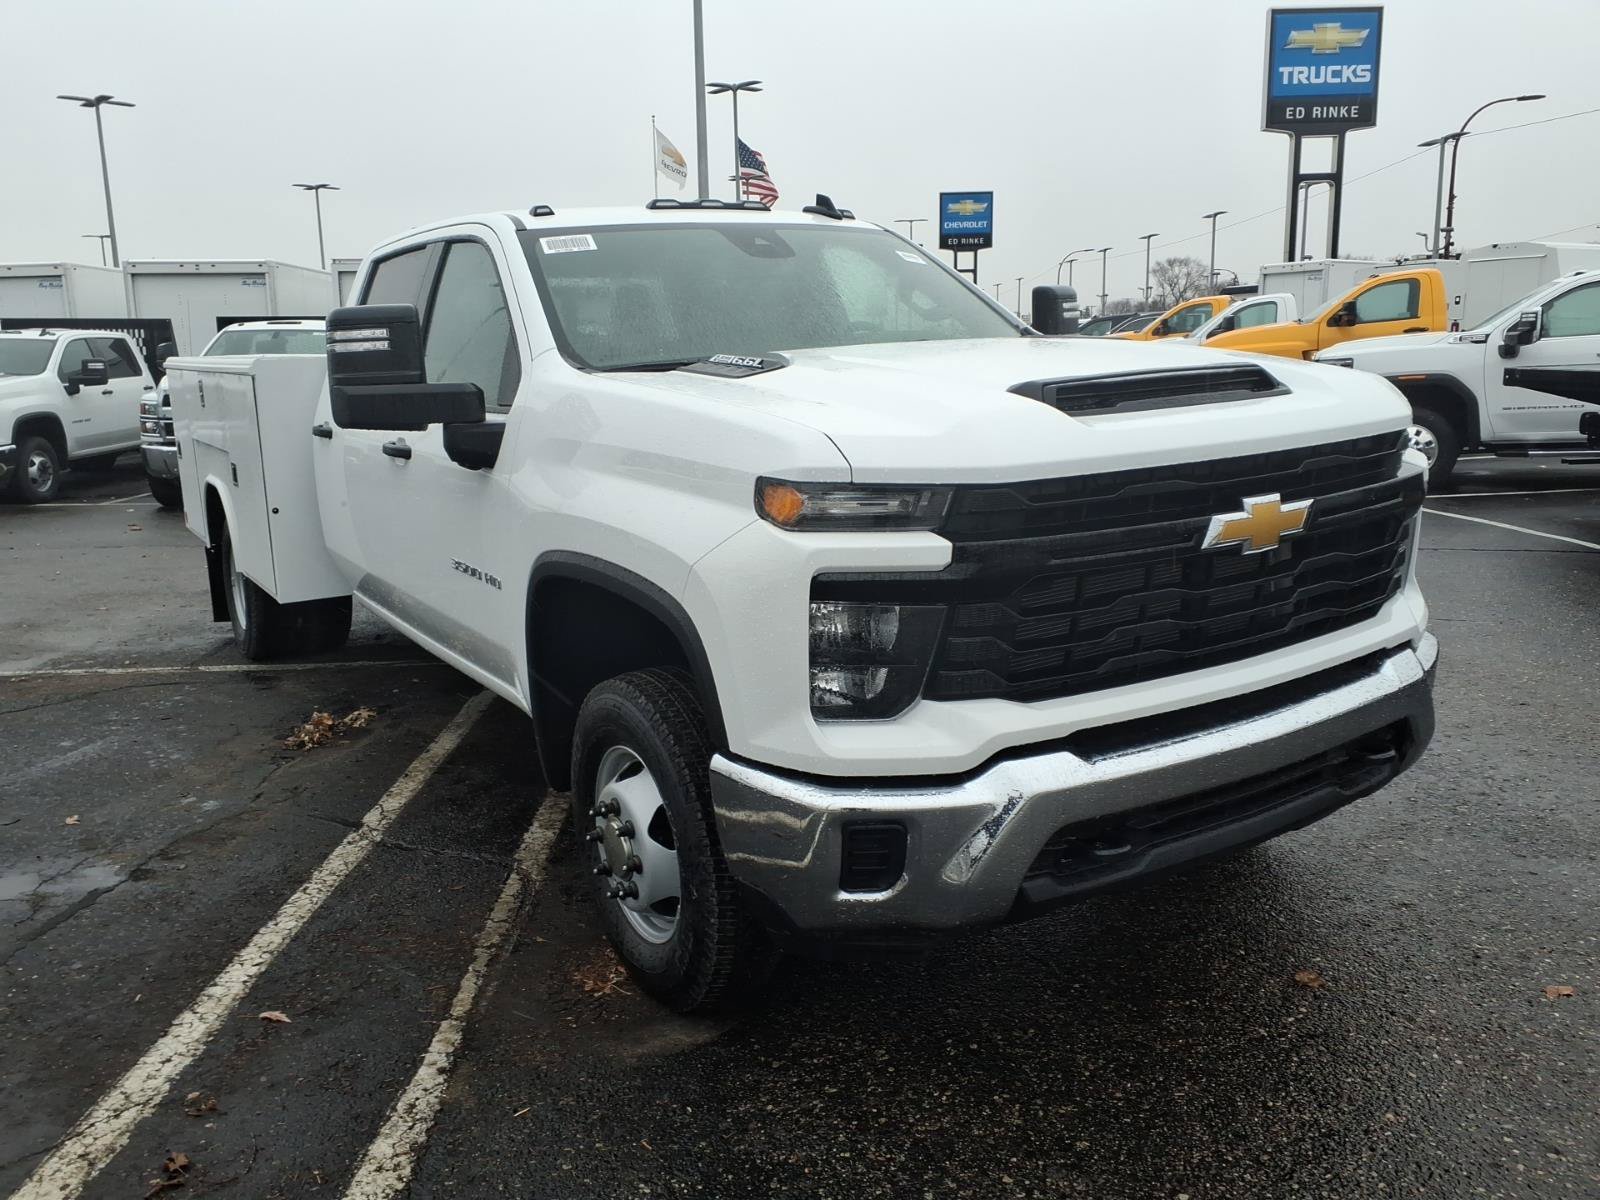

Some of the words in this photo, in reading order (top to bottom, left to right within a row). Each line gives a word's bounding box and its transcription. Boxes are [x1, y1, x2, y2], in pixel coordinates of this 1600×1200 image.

[1279, 65, 1371, 84] TRUCKS
[1286, 107, 1305, 119] ED
[1312, 106, 1359, 118] RINKE
